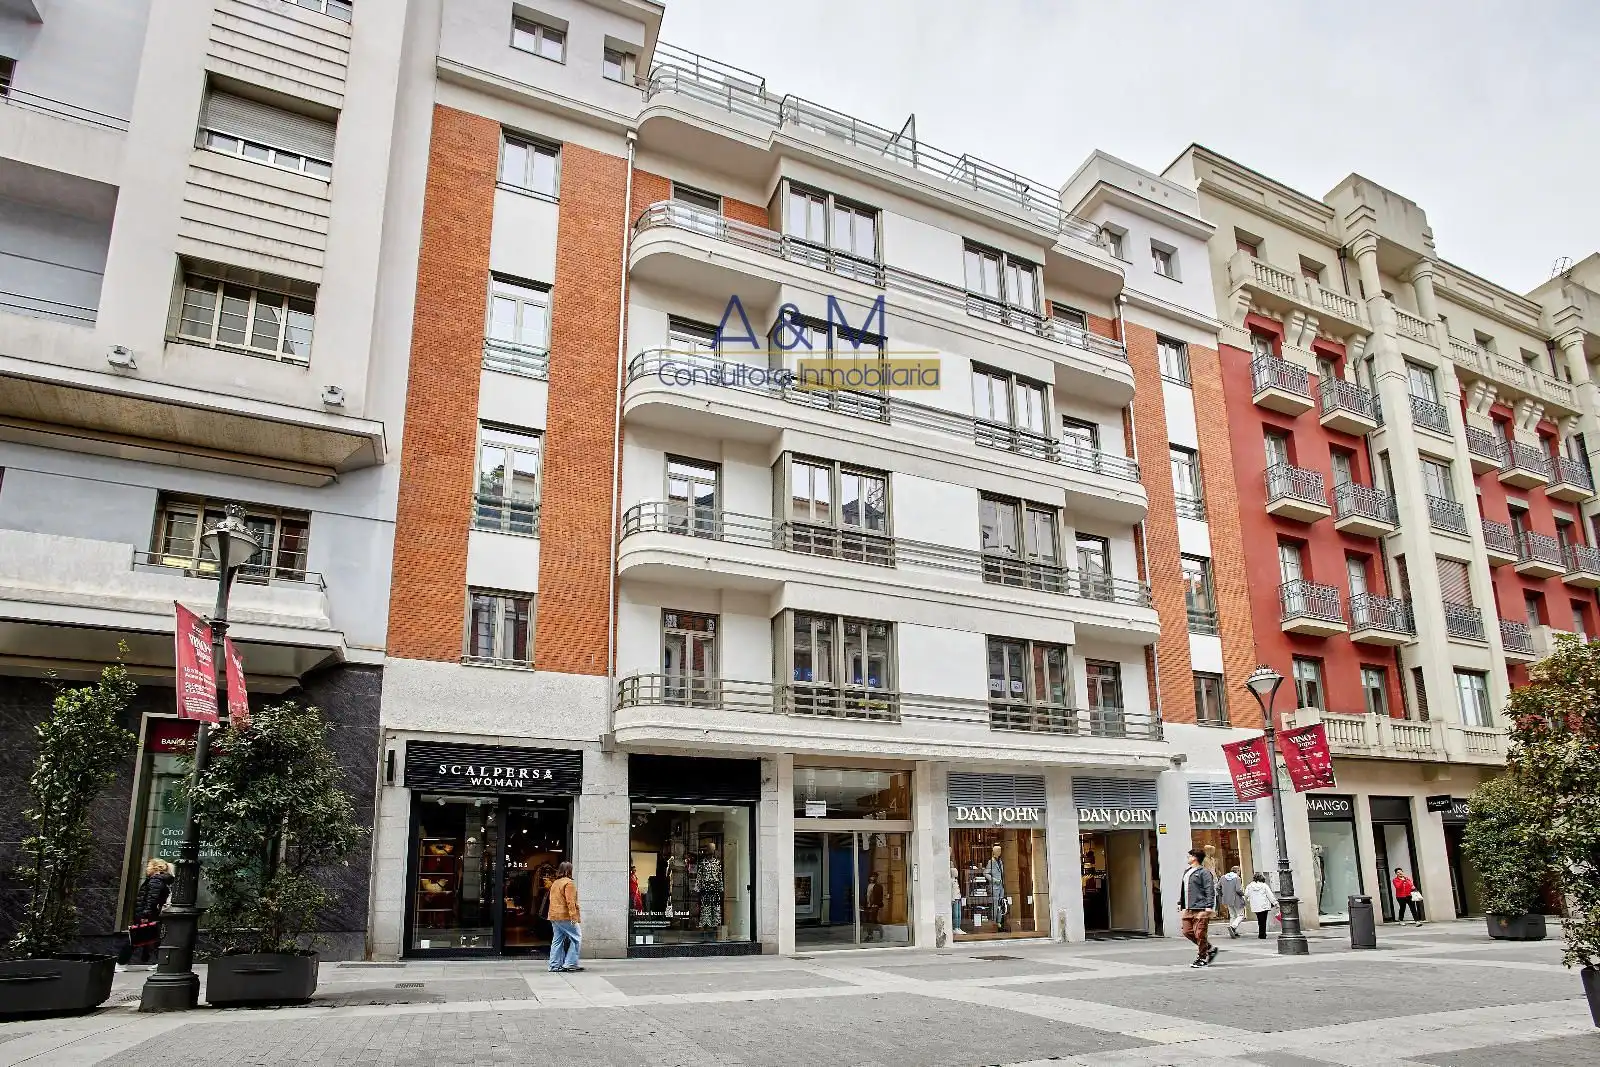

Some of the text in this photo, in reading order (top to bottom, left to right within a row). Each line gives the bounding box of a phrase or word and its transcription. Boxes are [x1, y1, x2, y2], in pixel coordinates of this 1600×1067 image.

[438, 764, 540, 779] SCALPERS
[470, 777, 523, 788] WOMAN
[1306, 799, 1349, 811] MANGO
[956, 806, 1040, 825] DAN JOHN
[1079, 808, 1152, 826] DAN JOHN
[1190, 810, 1253, 827] DAN JOHN
